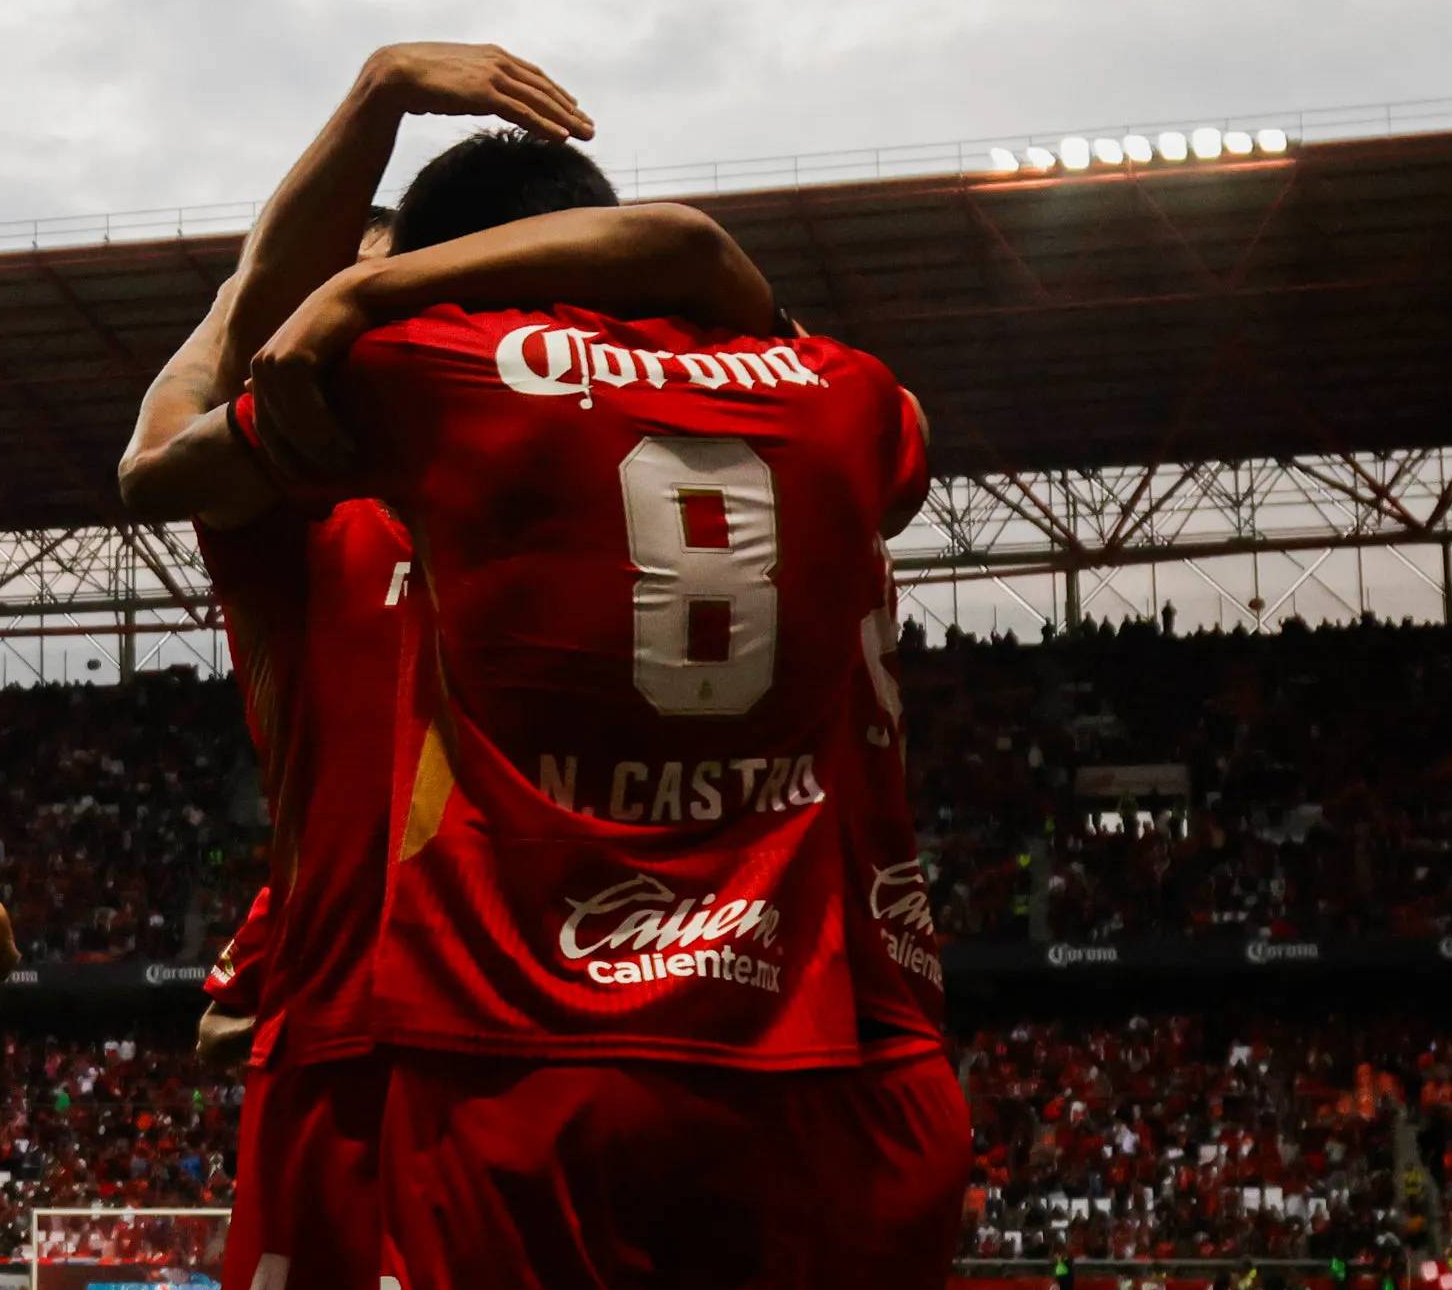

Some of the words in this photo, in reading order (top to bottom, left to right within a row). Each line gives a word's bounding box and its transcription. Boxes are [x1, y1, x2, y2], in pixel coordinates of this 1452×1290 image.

[496, 323, 820, 409] Corona
[618, 436, 781, 716] 8
[540, 754, 595, 816] N.
[610, 755, 826, 821] CASTRO
[587, 945, 782, 993] caliente.mx
